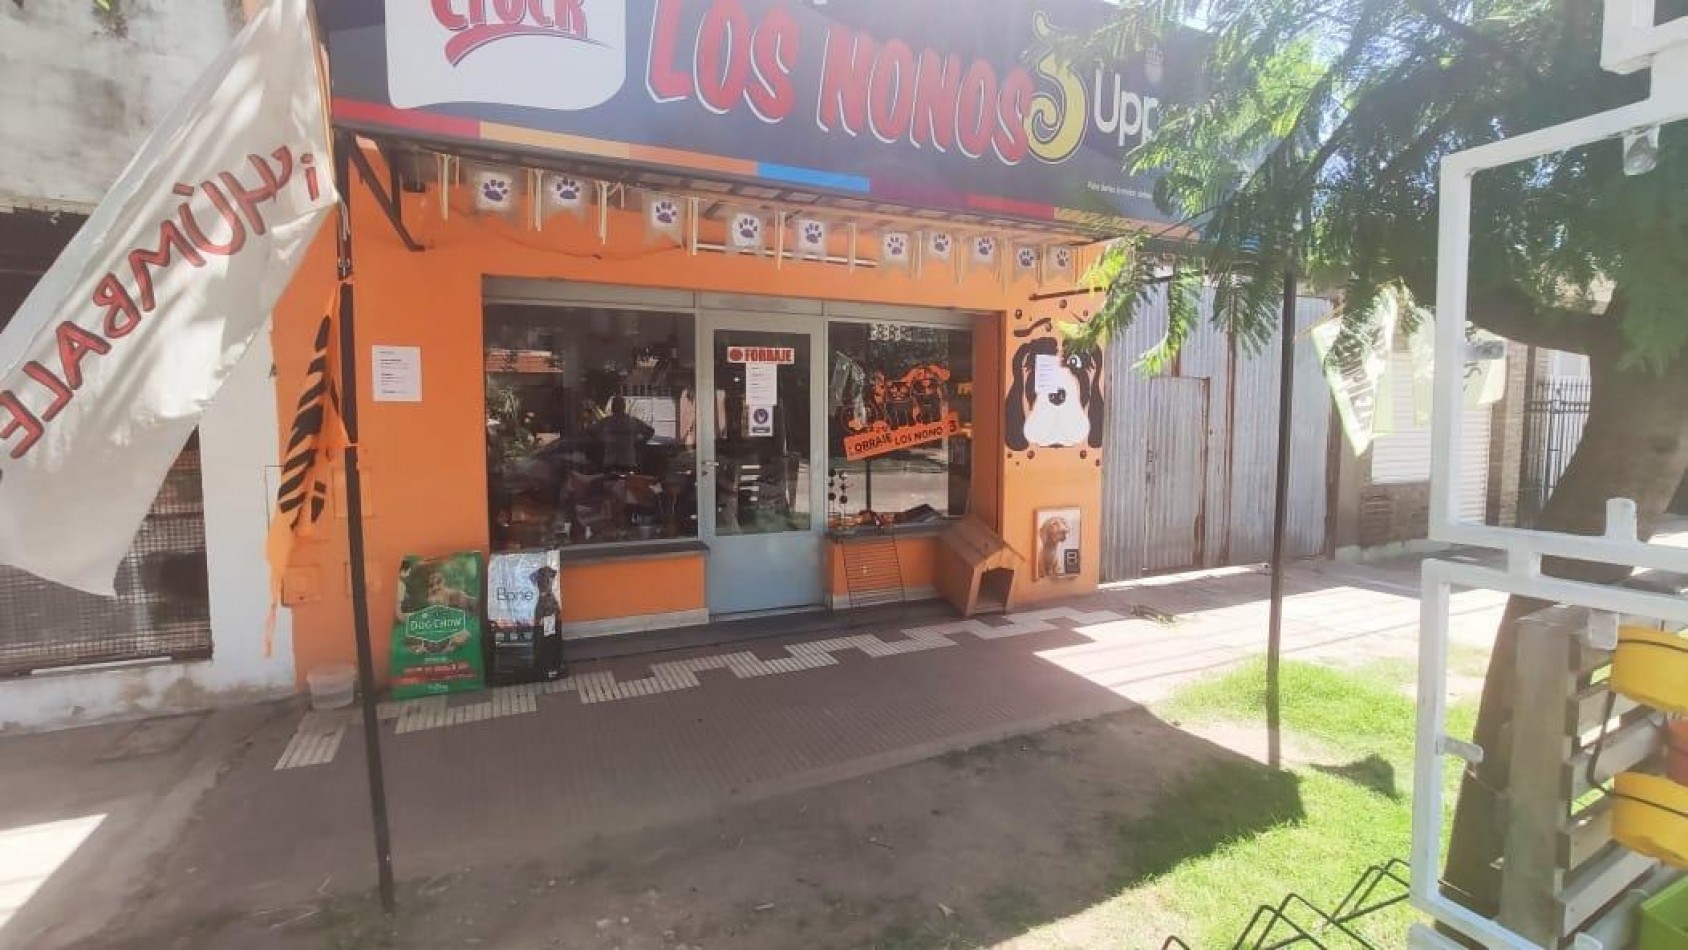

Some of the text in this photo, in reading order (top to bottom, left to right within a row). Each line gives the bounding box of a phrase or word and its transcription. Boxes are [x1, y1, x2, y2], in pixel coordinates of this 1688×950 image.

[646, 0, 797, 124] LOS
[816, 22, 1037, 166] NONOS
[1094, 68, 1159, 147] Upp
[847, 432, 892, 457] ORRAJE
[914, 426, 943, 440] NONO
[410, 616, 463, 631] DOG CHOW
